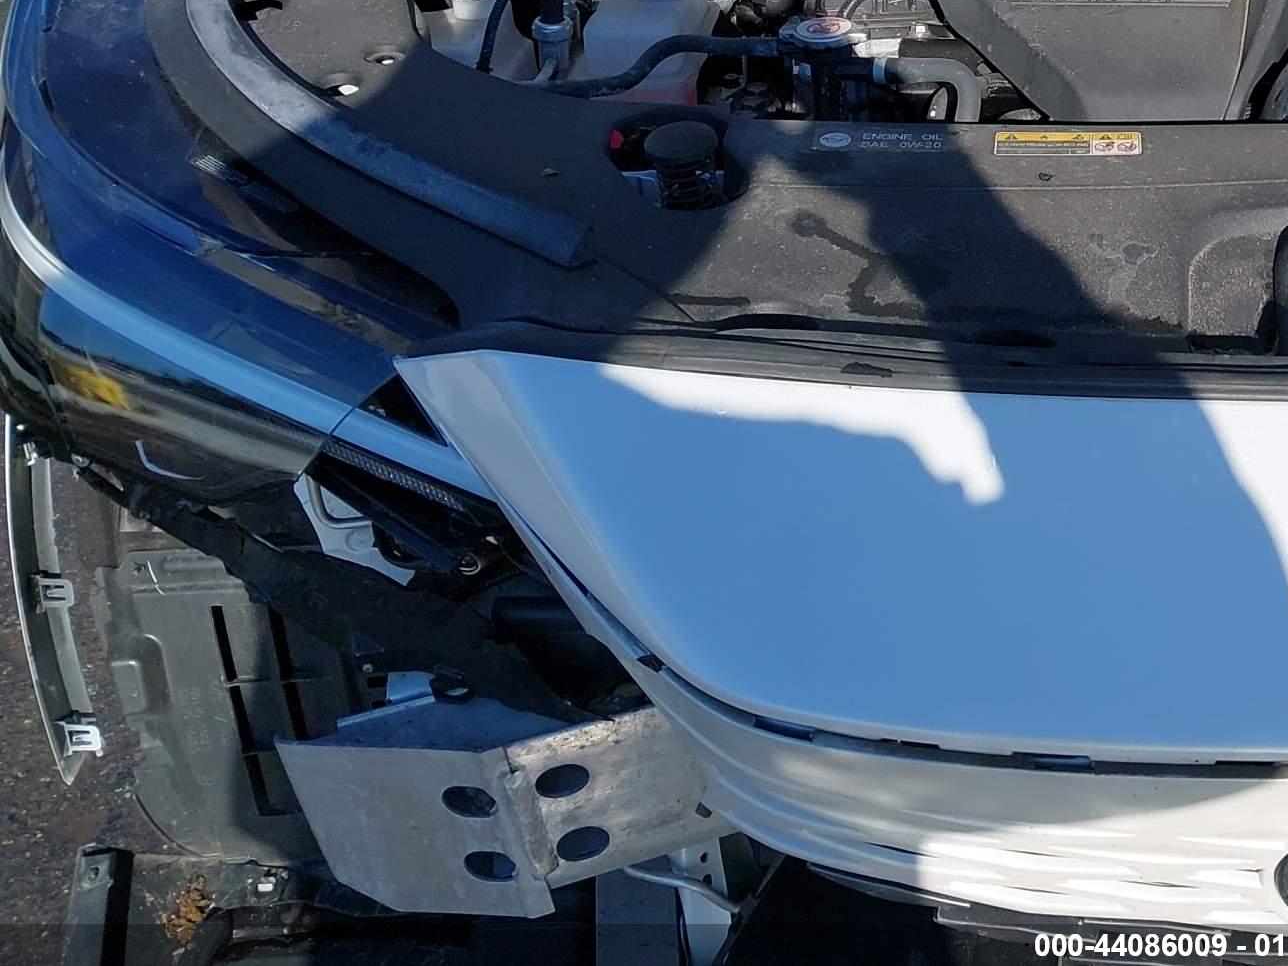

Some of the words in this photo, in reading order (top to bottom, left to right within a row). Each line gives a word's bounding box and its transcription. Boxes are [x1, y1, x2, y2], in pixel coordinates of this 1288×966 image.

[862, 133, 913, 141] ENGINE
[921, 133, 944, 141] OIL
[899, 141, 943, 149] 0W-20
